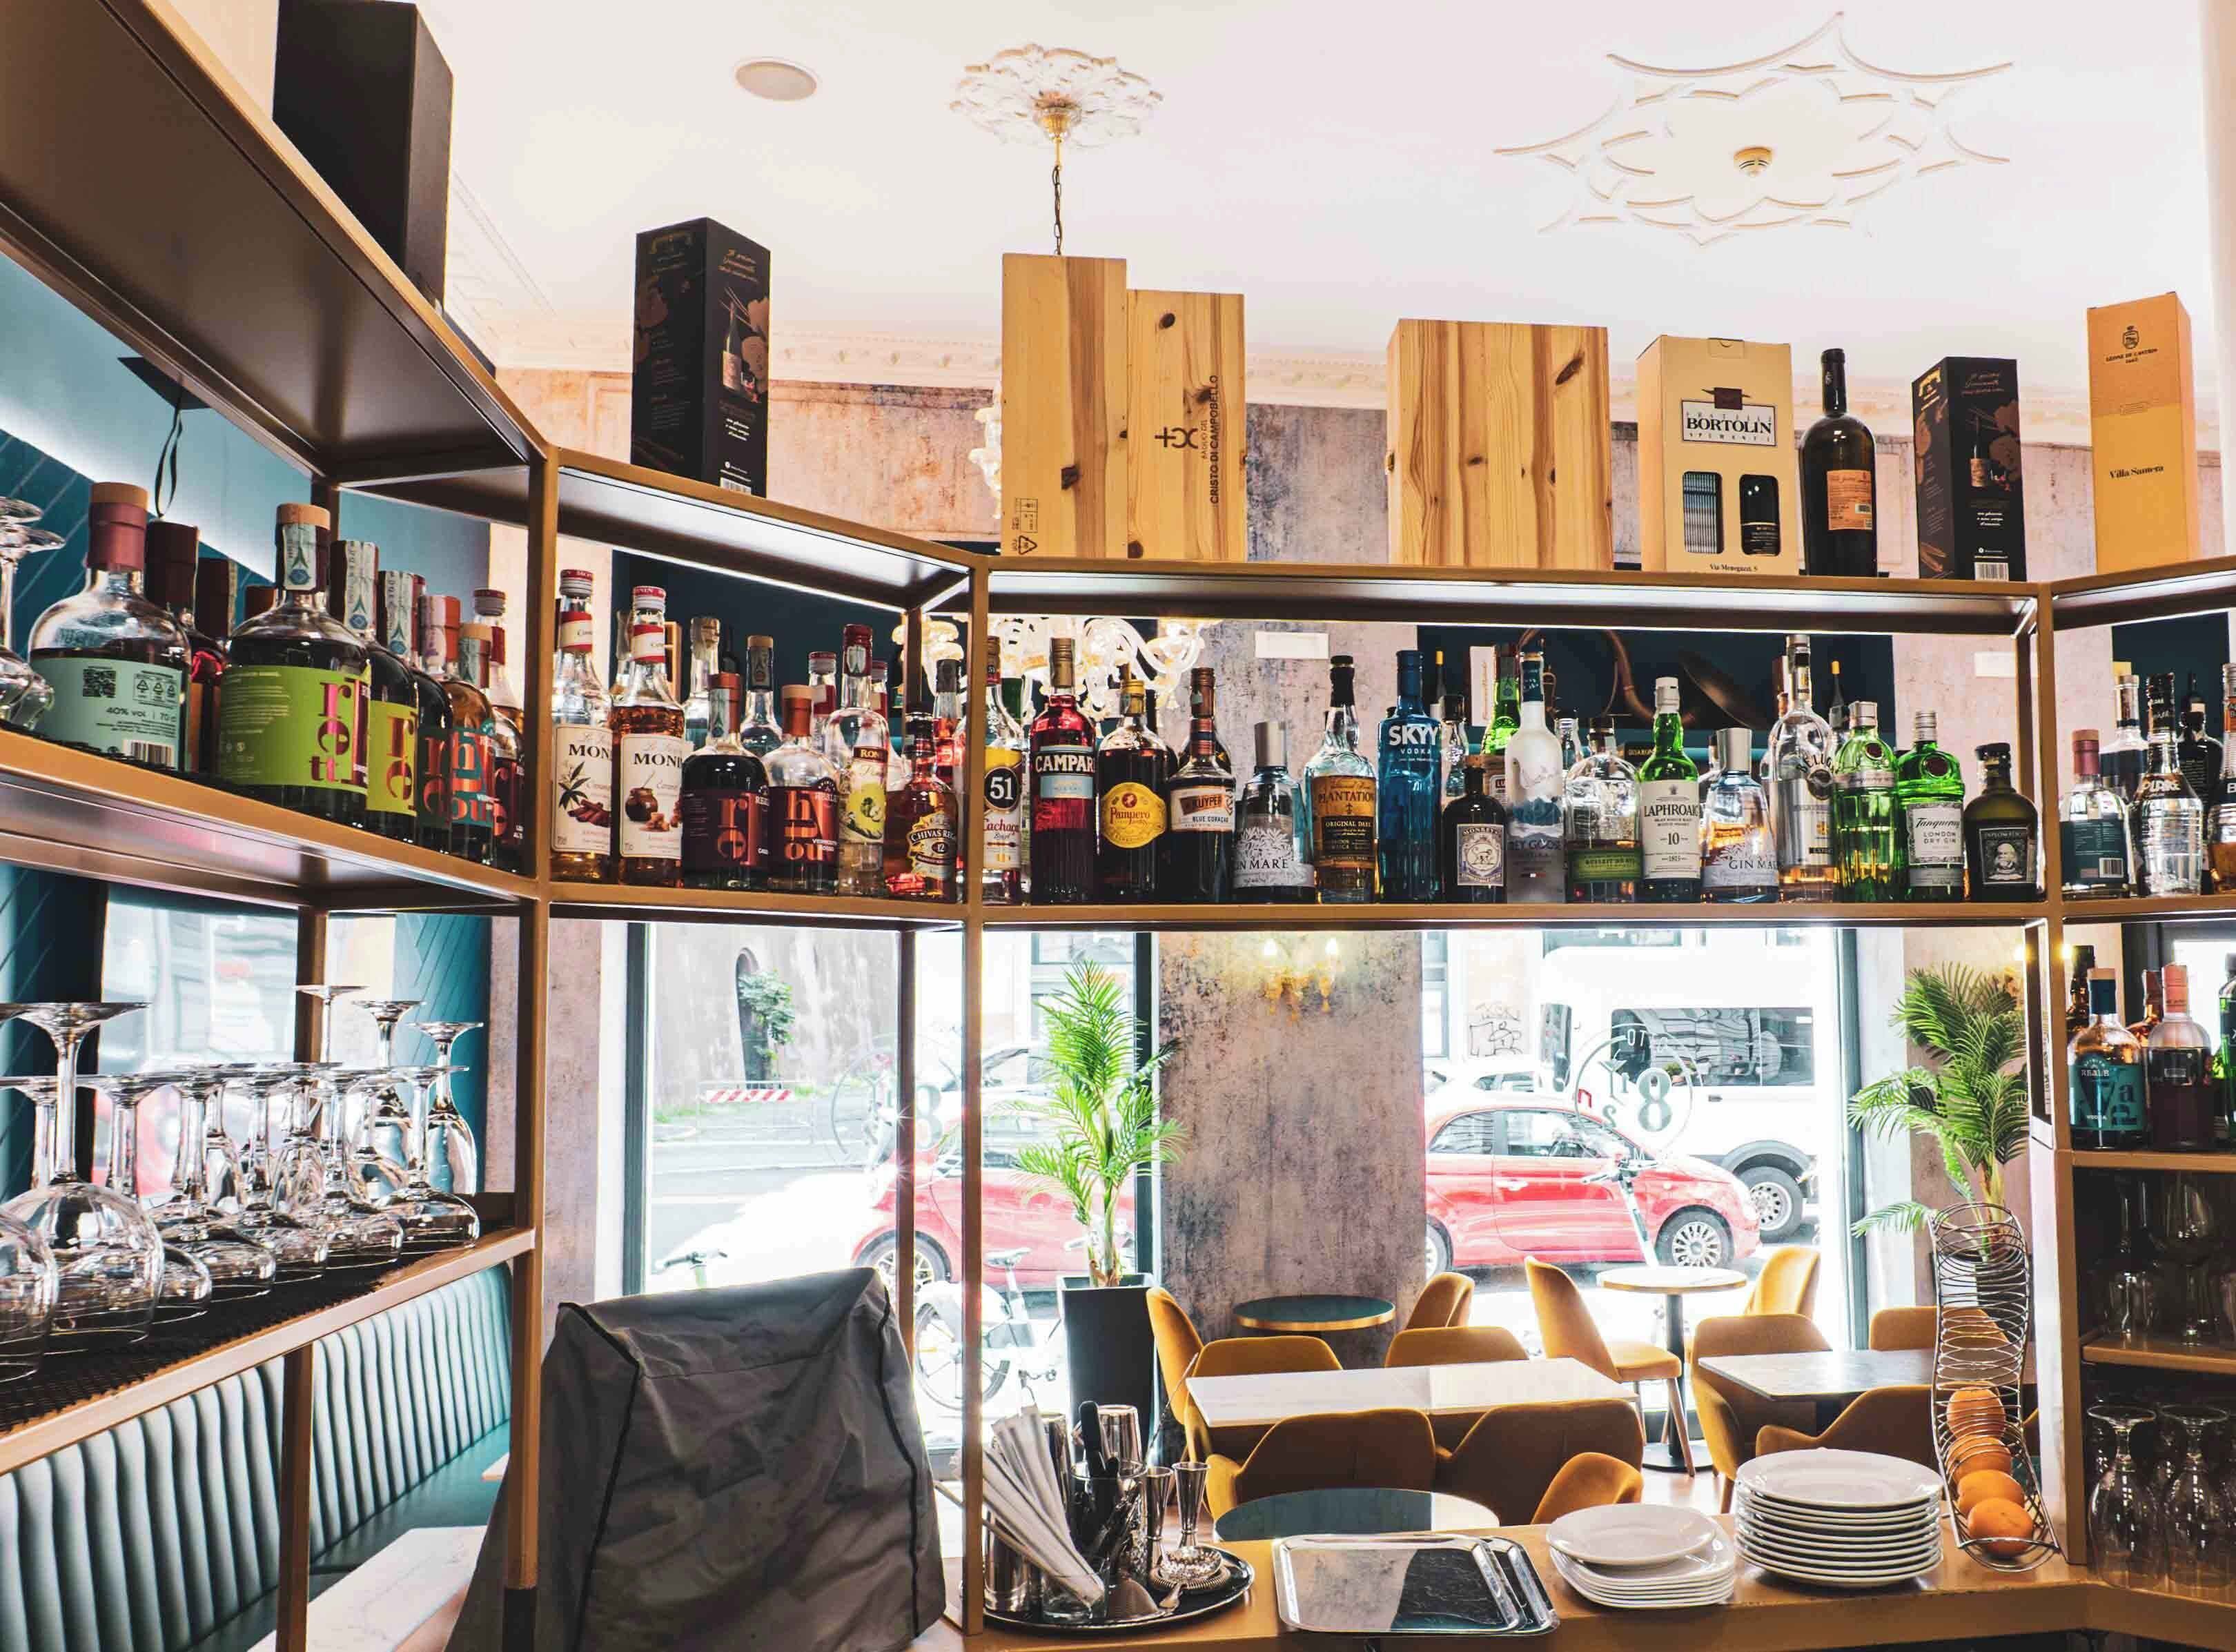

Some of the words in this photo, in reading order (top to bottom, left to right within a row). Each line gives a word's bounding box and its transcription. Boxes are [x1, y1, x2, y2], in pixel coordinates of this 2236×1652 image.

[1209, 375, 1219, 449] CAMPOBELLO
[1686, 417, 1772, 435] BORTOLIN
[1209, 452, 1219, 462] DI
[1209, 466, 1219, 504] CRISTO
[106, 707, 129, 716] 40%
[1389, 725, 1439, 746] SKYY
[990, 776, 1014, 800] 51
[1193, 815, 1207, 823] BLUE
[1914, 817, 1961, 829] Tanqueray
[910, 829, 941, 842] CHIVAS
[1667, 832, 1680, 845] 10
[936, 843, 945, 853] 12
[1249, 858, 1289, 870] MARE
[1729, 860, 1754, 869] GIN
